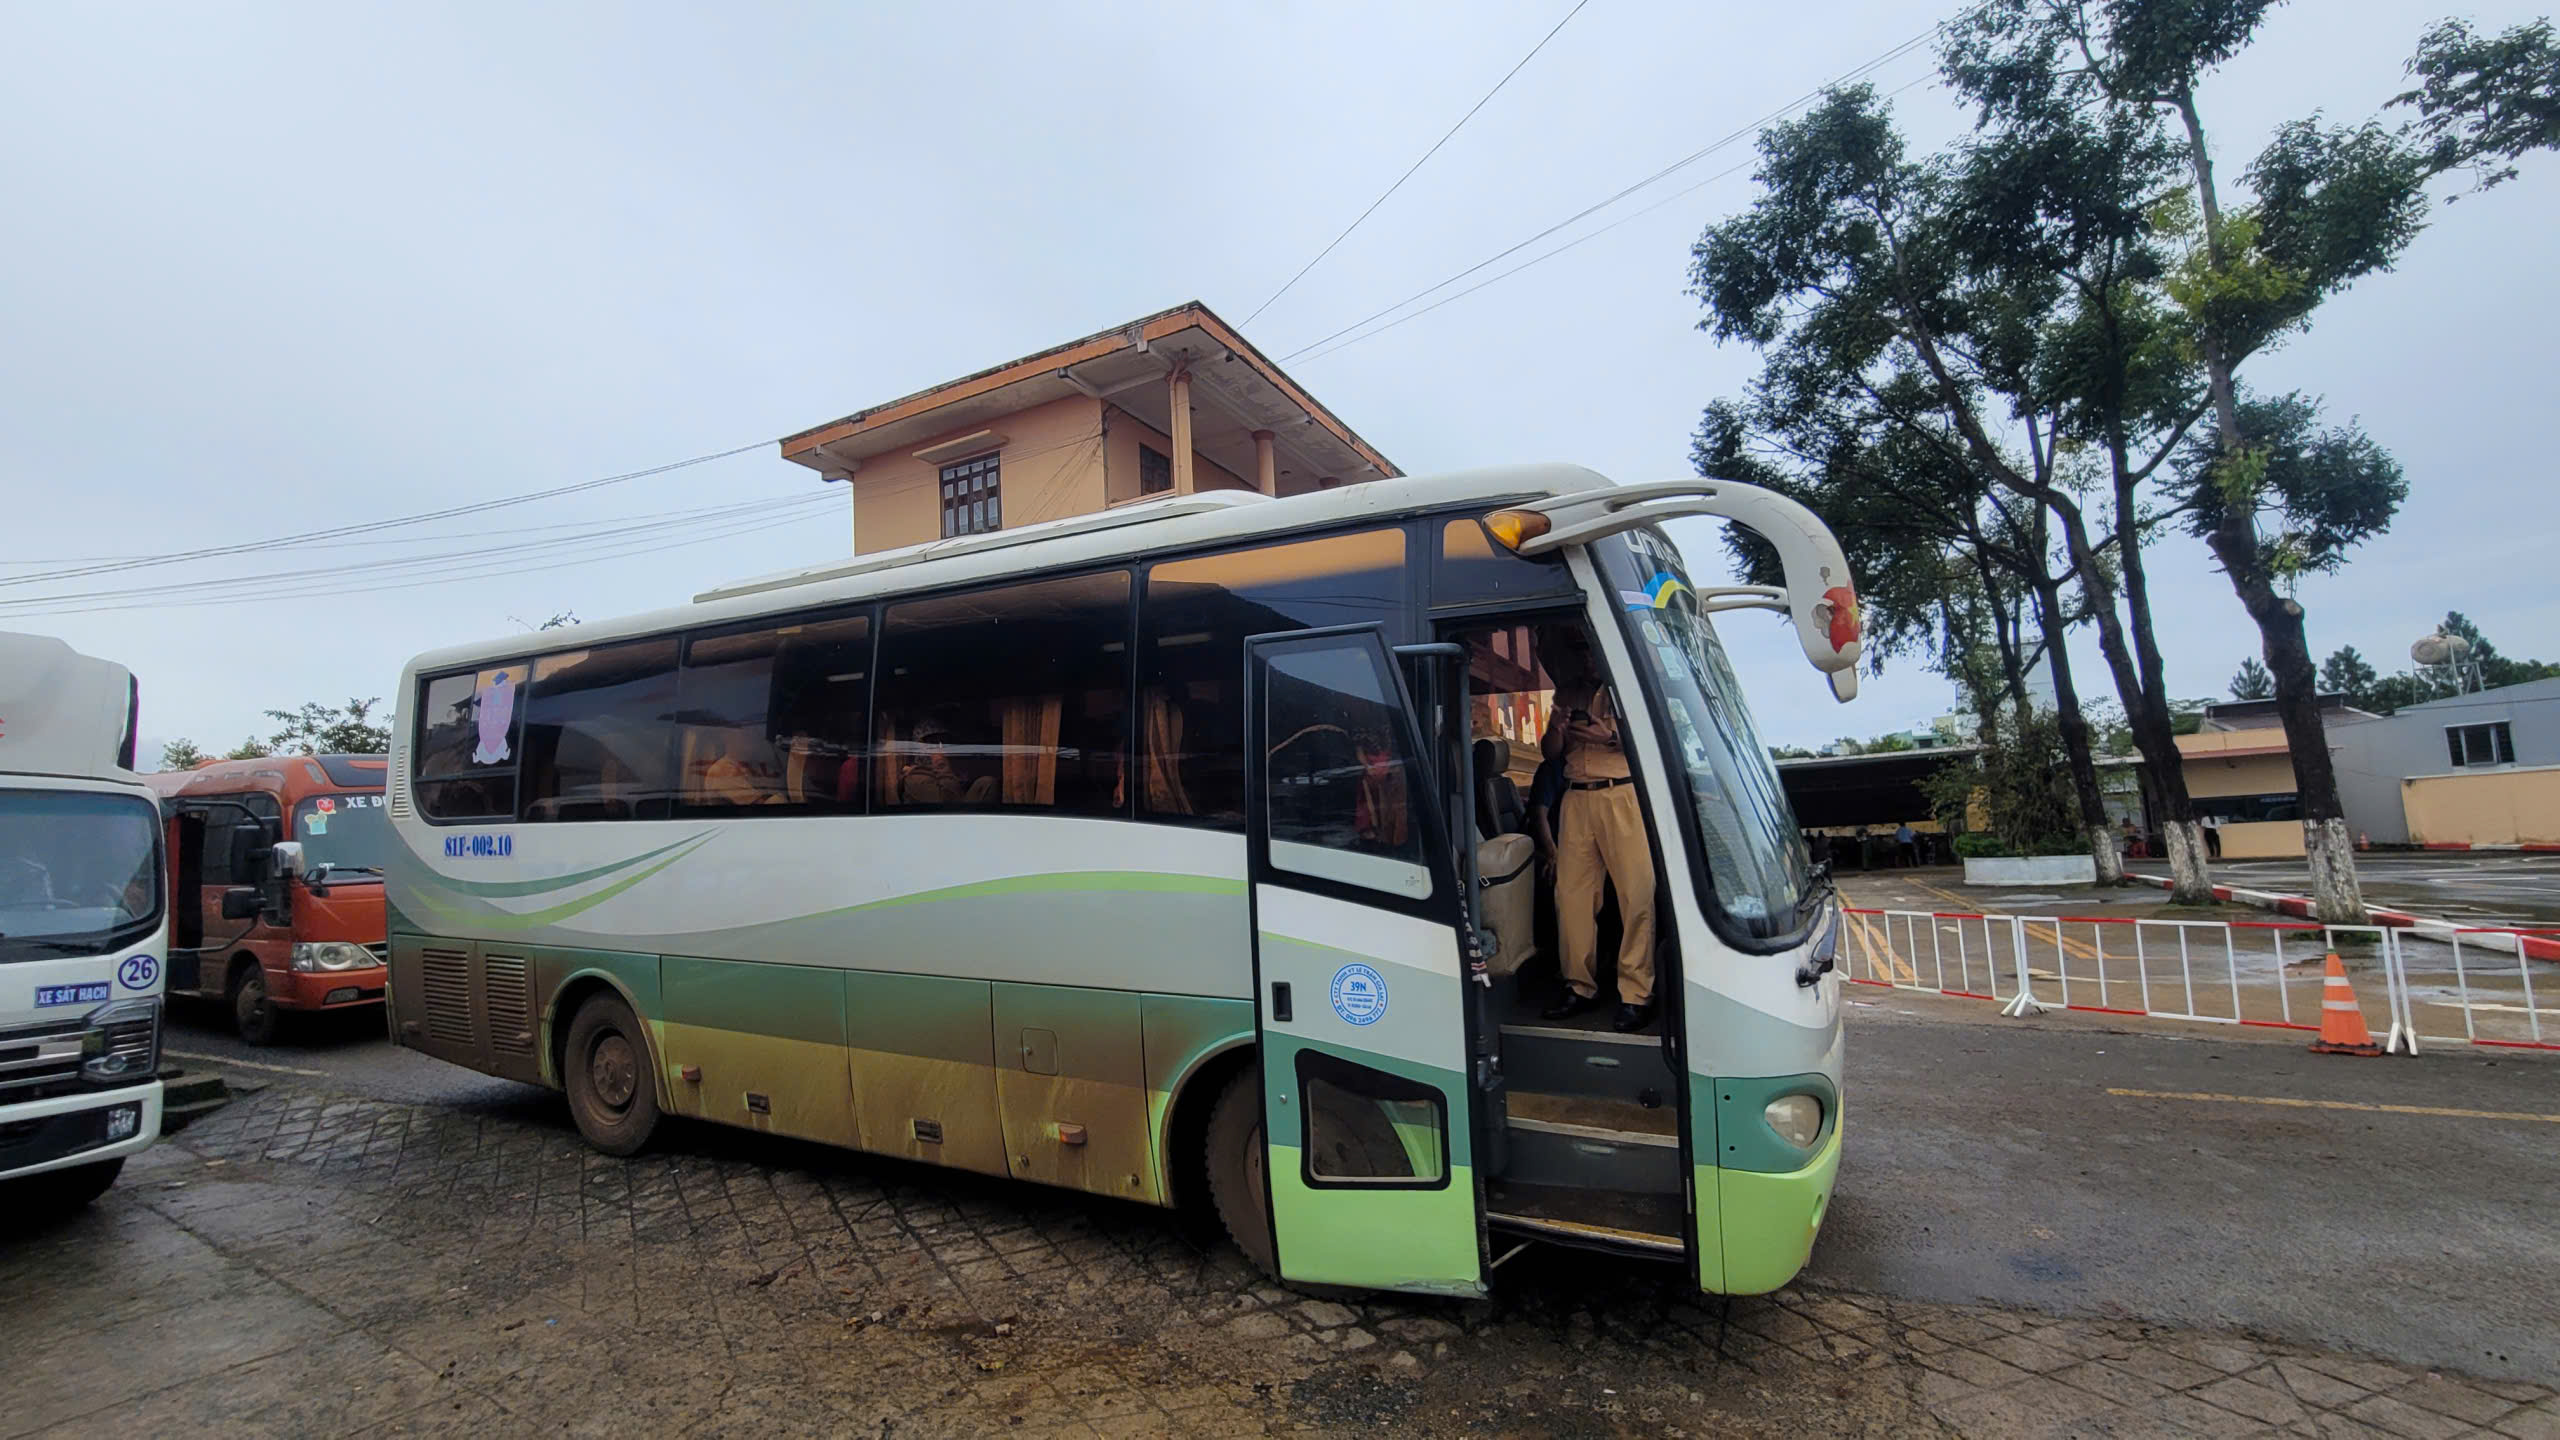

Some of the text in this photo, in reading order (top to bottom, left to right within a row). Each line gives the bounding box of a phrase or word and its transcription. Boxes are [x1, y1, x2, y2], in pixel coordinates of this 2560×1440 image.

[345, 796, 367, 808] XE
[128, 959, 152, 981] 26
[1350, 981, 1367, 992] 39N
[39, 991, 53, 1004] XE
